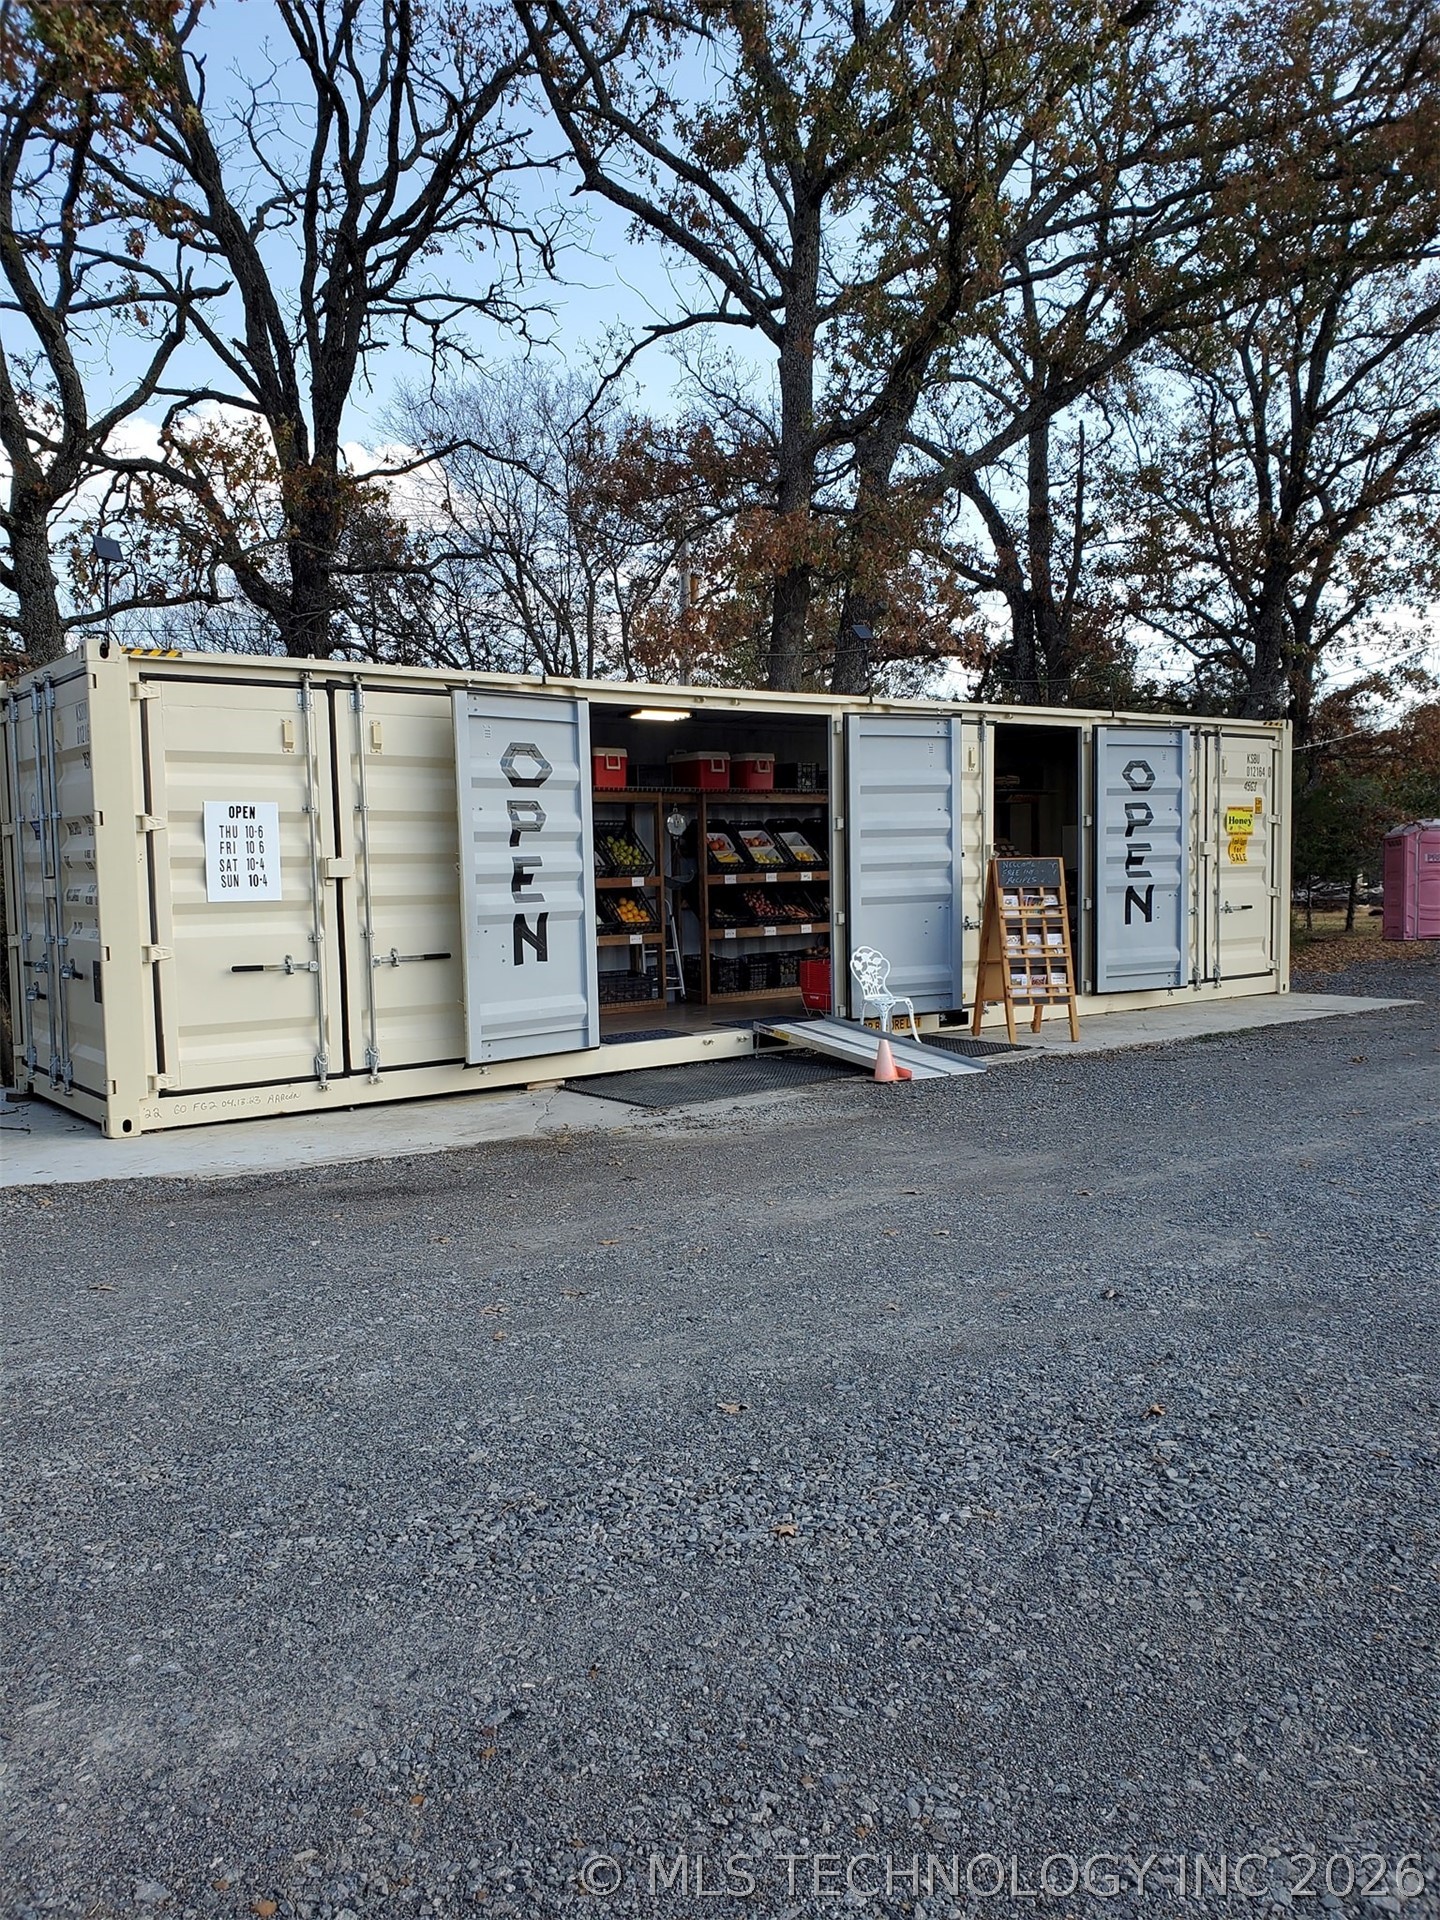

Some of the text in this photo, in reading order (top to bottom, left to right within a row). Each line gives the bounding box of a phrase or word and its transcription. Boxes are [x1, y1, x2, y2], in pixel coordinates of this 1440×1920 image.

[228, 806, 256, 819] OPEN
[1228, 816, 1252, 827] Honey
[219, 825, 264, 838] THU 10-6
[219, 841, 236, 854] FRI
[1121, 760, 1156, 925] OPEN
[500, 742, 553, 966] OPEN
[1231, 853, 1248, 861] SALE
[219, 858, 265, 872] SAT 10-4
[220, 874, 268, 888] SUN 10-4
